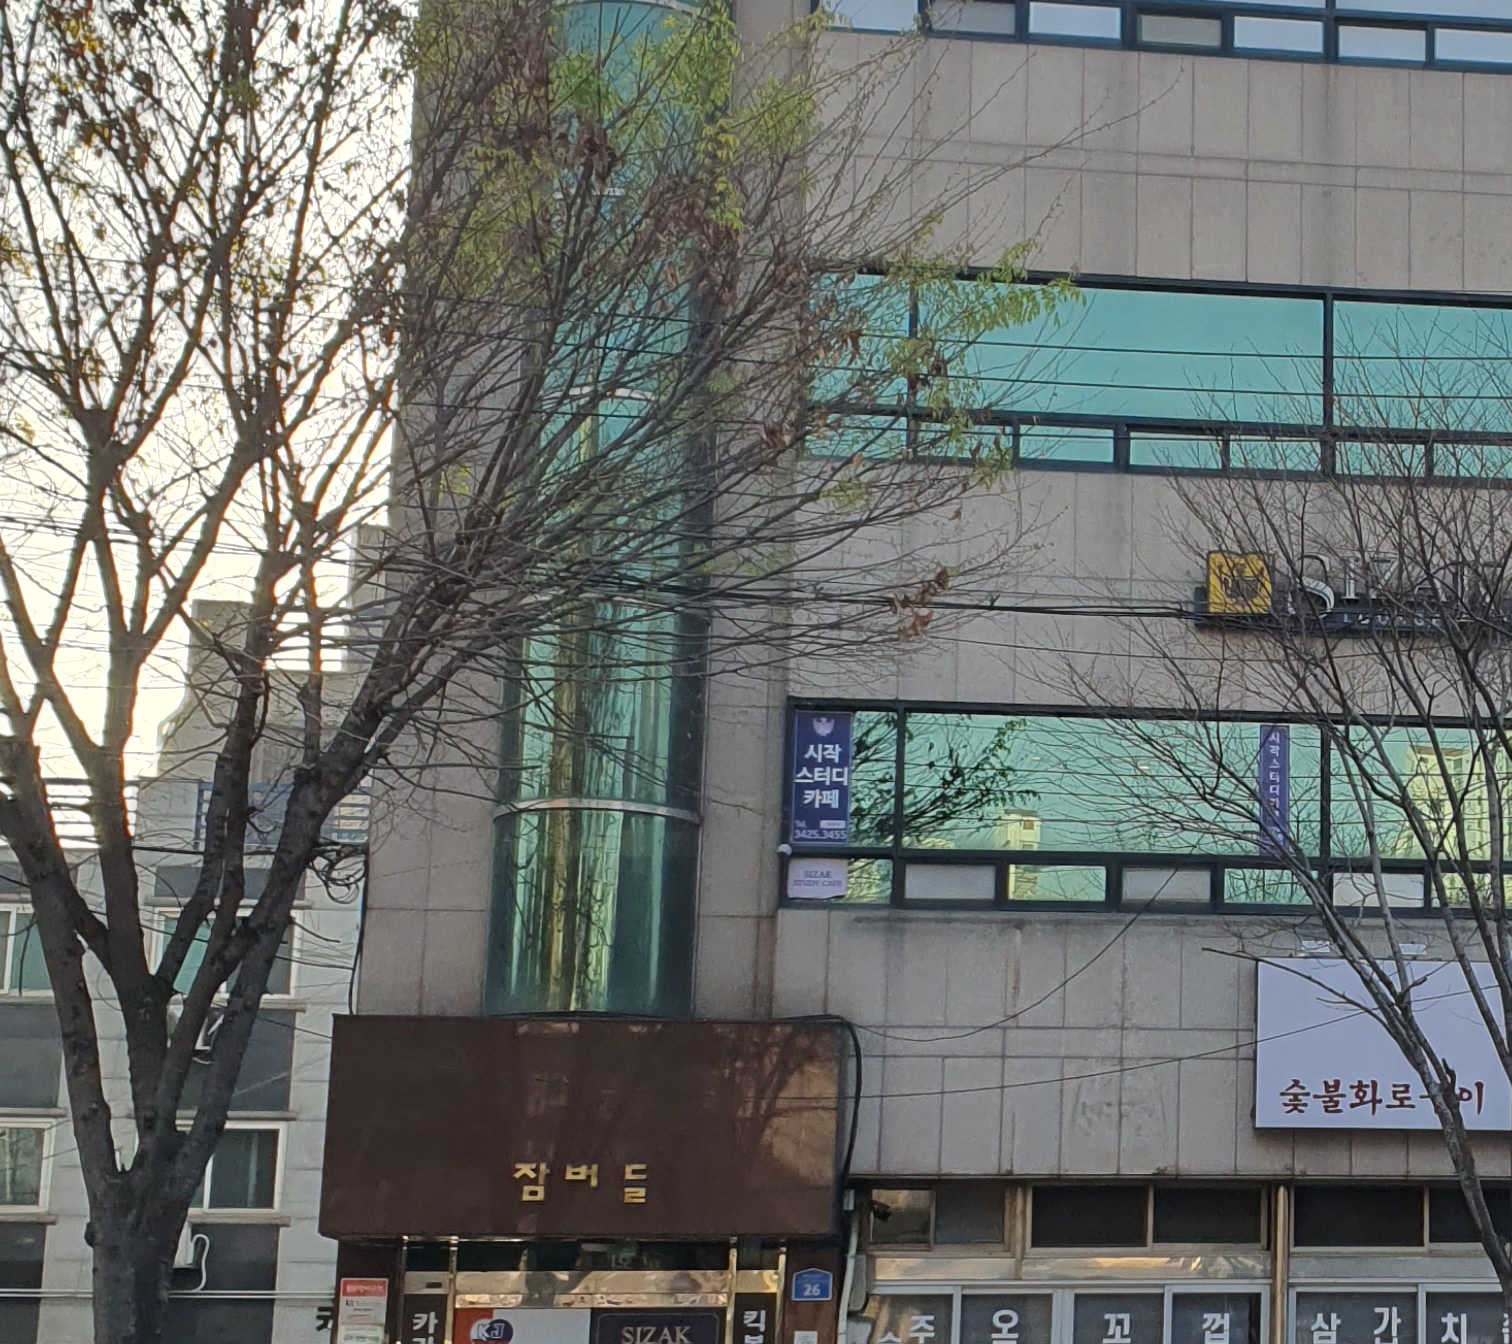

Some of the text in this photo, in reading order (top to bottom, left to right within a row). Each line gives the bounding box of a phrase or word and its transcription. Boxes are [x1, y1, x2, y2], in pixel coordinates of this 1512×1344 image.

[804, 743, 843, 763] 시작
[793, 766, 849, 786] 스터디
[803, 789, 840, 809] 카페
[1279, 1077, 1485, 1116] 숯불화로이
[803, 1284, 821, 1296] 26
[476, 1322, 506, 1342] KJ
